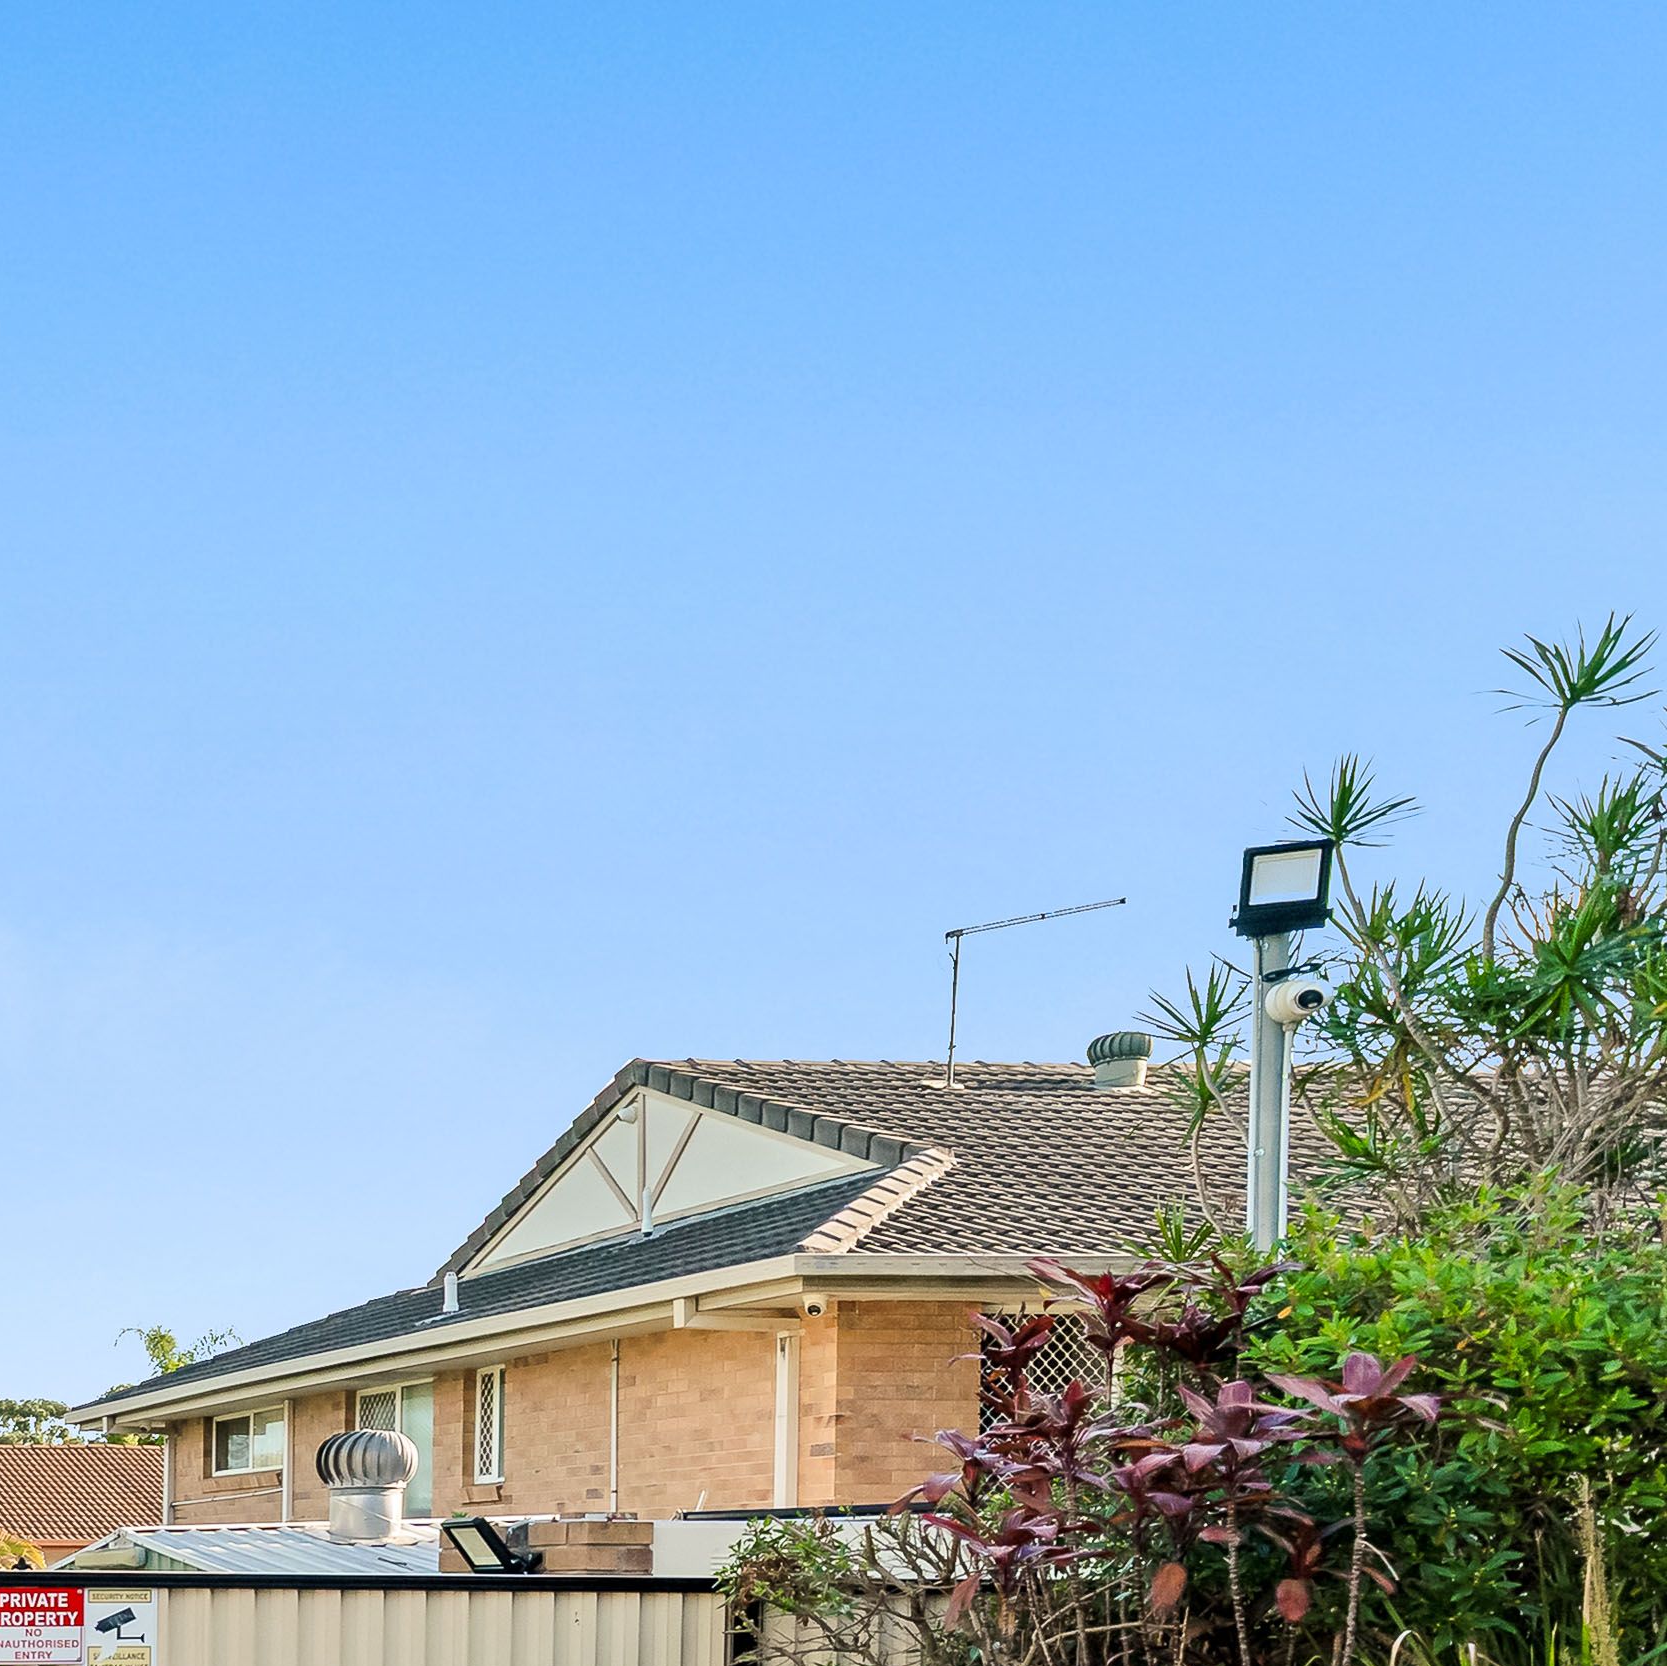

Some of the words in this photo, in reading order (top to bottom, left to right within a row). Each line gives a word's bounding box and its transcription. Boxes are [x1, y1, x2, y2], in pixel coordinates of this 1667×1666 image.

[0, 1593, 68, 1608] PRIVATE
[25, 1628, 42, 1637] NO
[14, 1651, 53, 1660] ENTRY
